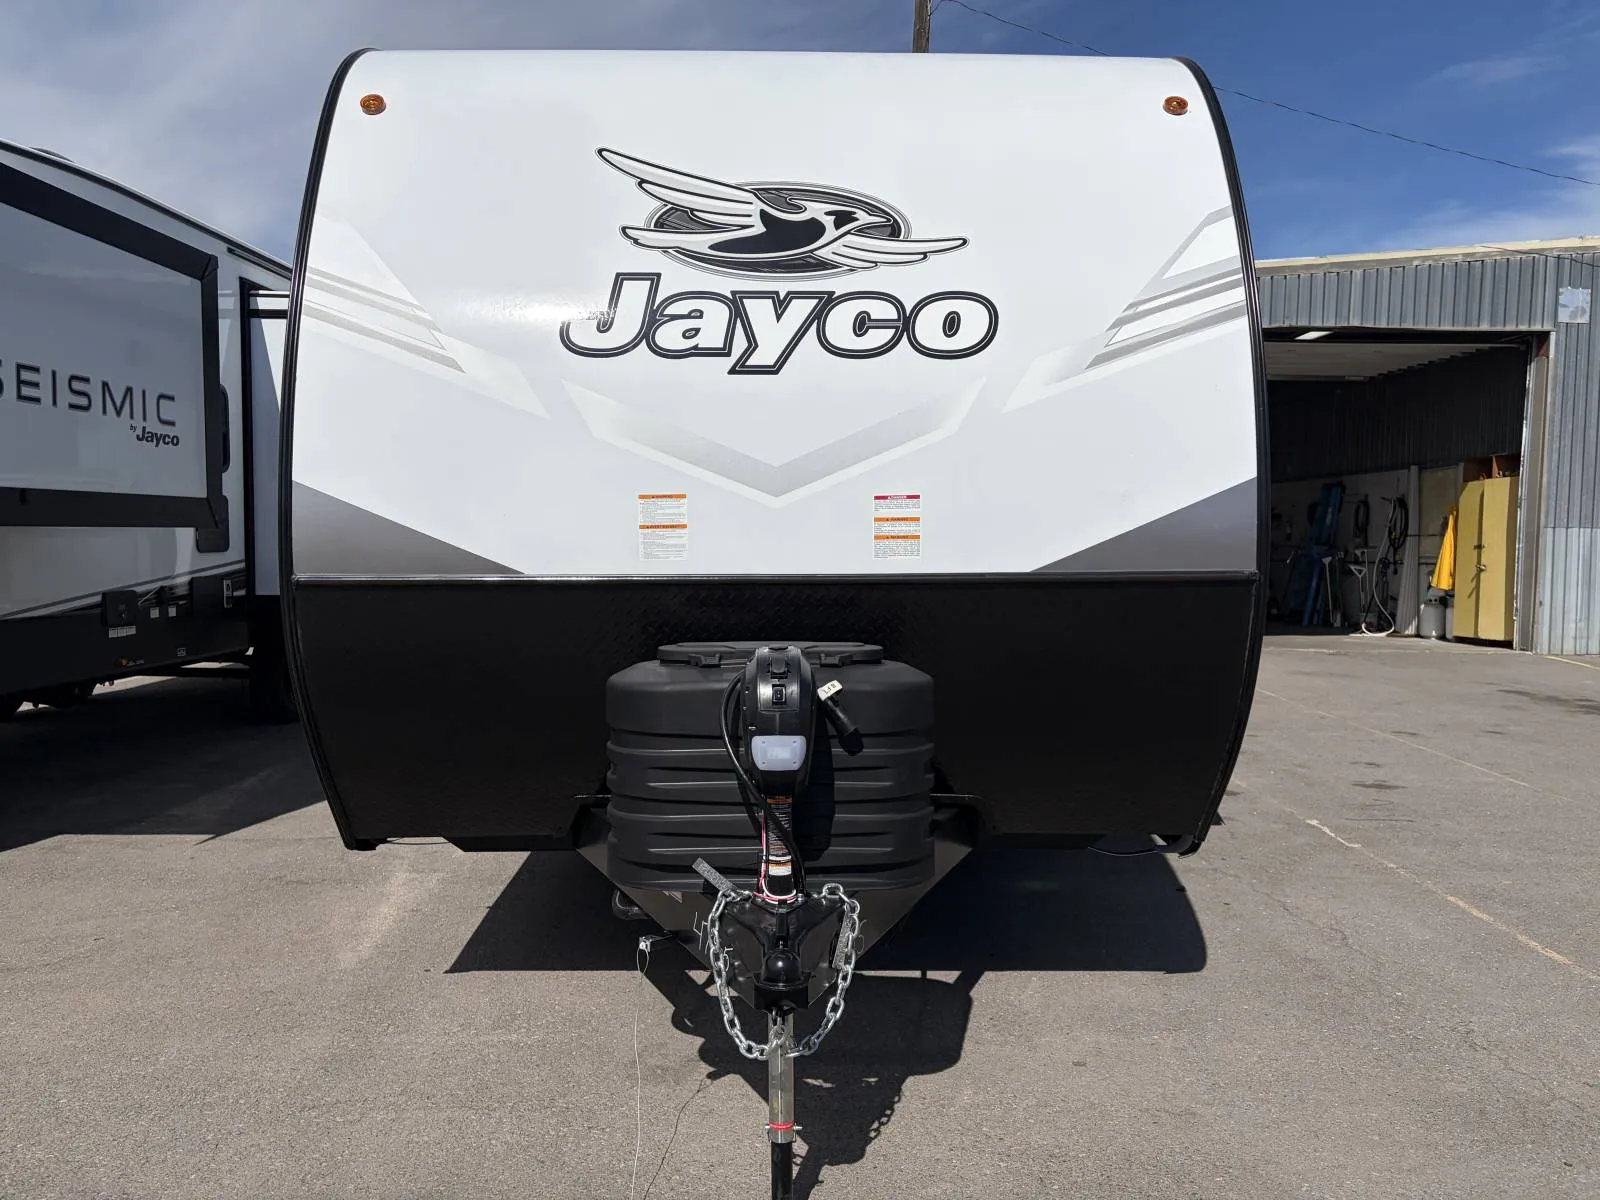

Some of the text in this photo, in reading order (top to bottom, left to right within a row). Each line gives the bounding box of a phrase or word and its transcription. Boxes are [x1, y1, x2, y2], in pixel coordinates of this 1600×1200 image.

[559, 272, 998, 375] Jayco
[0, 359, 176, 427] EISMIC
[130, 424, 180, 448] by Jayco
